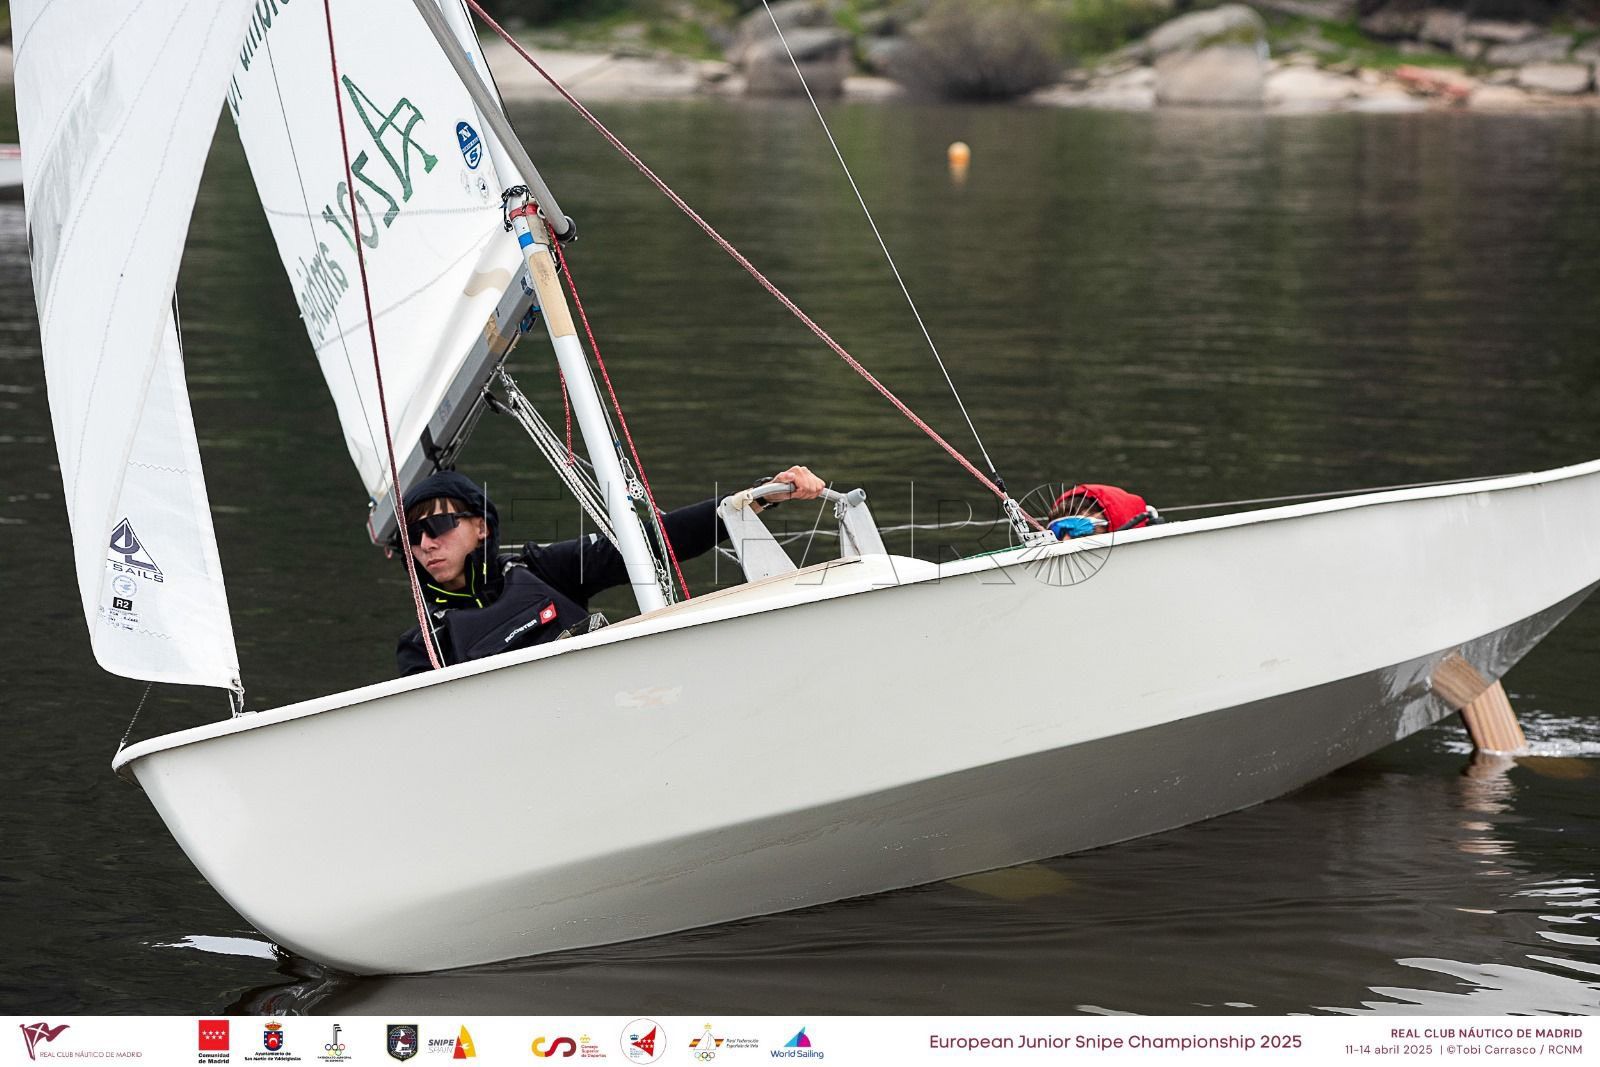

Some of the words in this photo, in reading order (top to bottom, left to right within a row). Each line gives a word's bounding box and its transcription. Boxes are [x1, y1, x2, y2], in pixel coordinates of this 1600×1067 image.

[113, 563, 164, 583] SAILS
[116, 599, 130, 610] R2
[504, 618, 538, 643] ROOSTER
